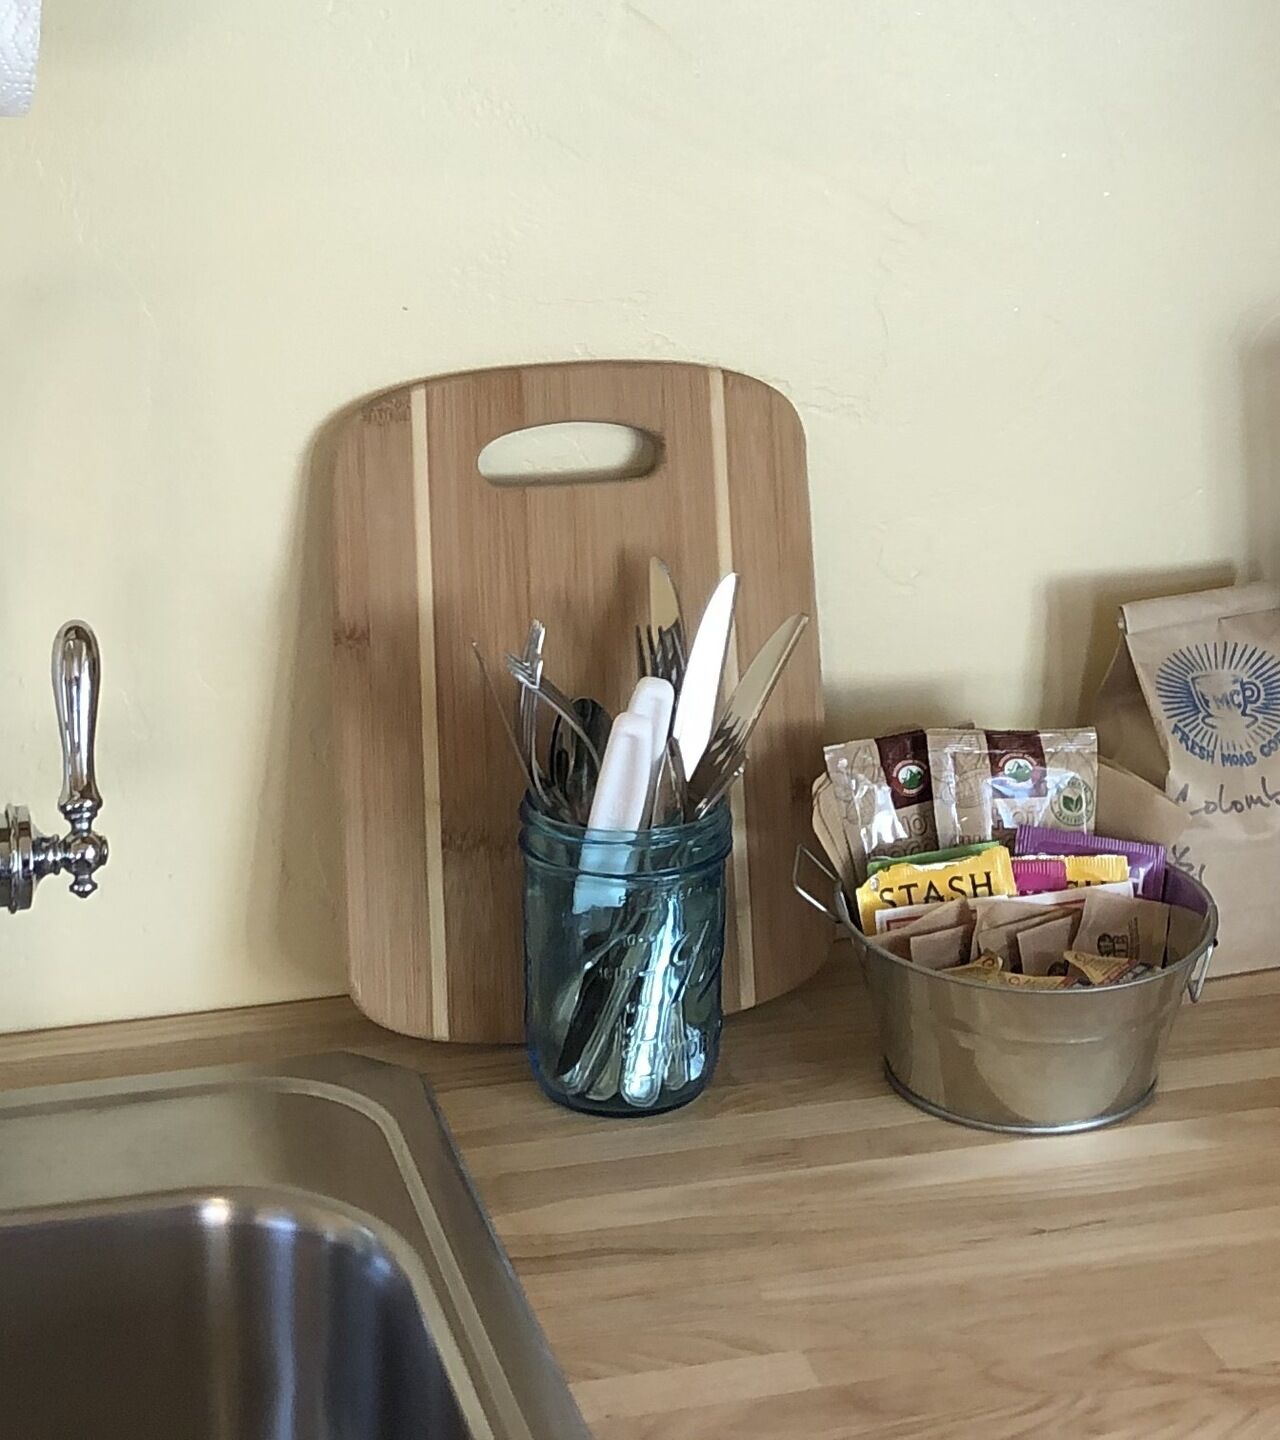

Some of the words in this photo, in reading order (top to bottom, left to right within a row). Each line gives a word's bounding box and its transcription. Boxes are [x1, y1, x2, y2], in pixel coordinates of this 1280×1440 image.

[1171, 723, 1215, 765] FRESH
[1220, 750, 1258, 768] MOAB
[878, 870, 995, 908] STASH
